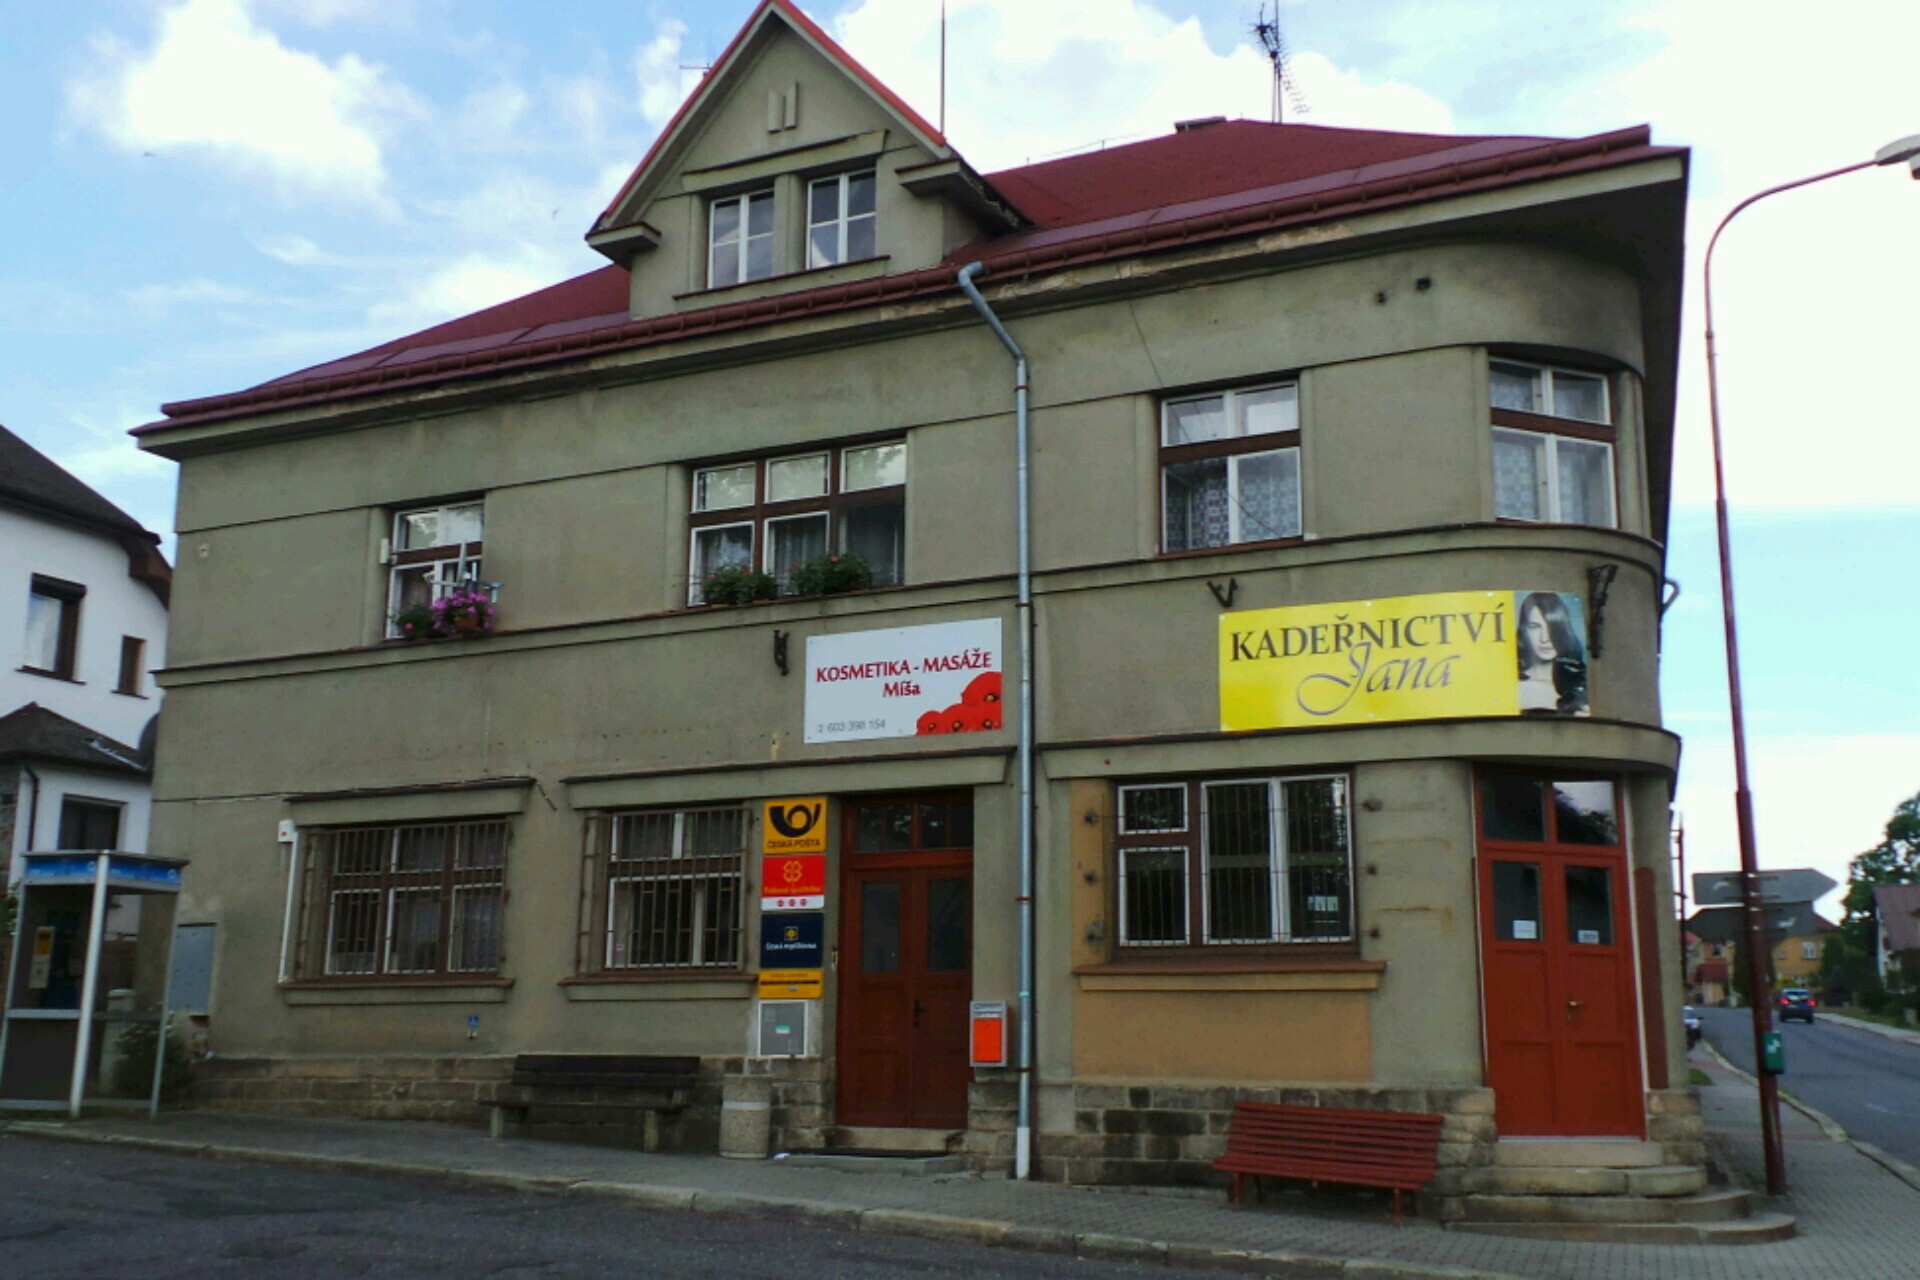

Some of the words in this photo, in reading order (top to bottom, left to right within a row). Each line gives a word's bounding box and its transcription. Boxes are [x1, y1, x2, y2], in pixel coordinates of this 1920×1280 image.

[1230, 602, 1506, 661] KADEŘNICTVÍ
[816, 659, 911, 682] KOSMETIKA
[923, 648, 992, 673] MASÁŽE
[1296, 641, 1461, 716] Jana
[883, 680, 921, 697] Míša
